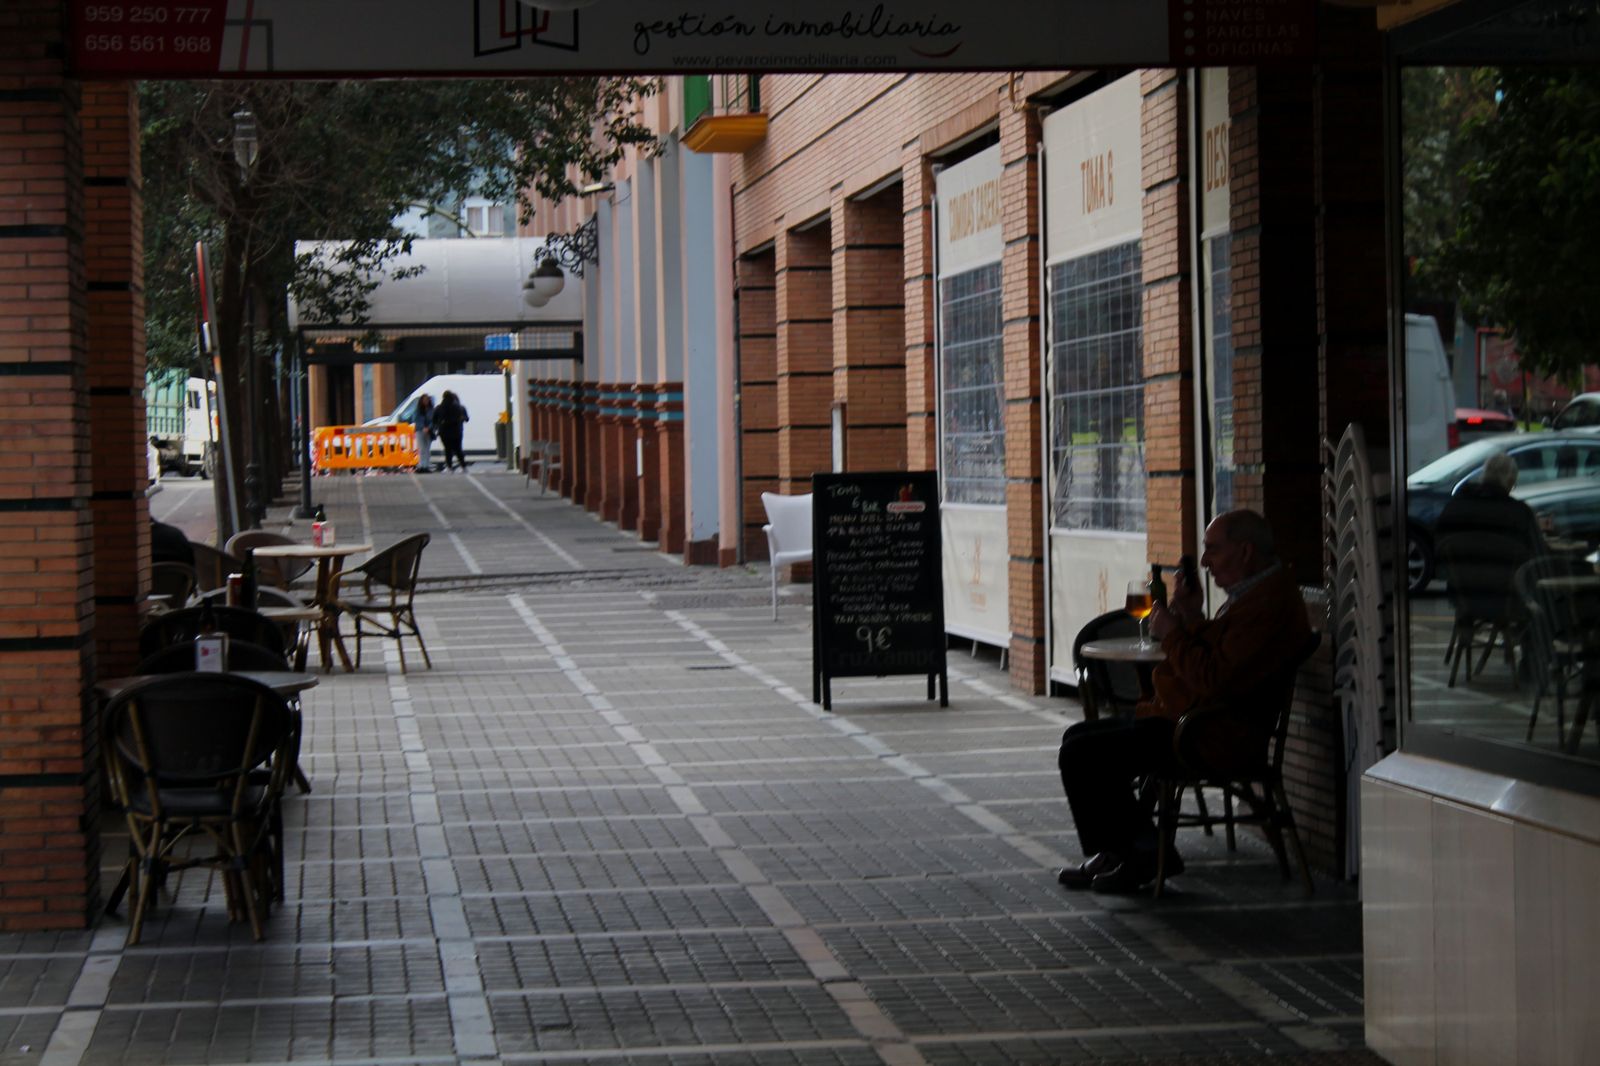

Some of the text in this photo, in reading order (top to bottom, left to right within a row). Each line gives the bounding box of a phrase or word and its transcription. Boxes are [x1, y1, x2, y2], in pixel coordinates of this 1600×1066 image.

[85, 5, 212, 23] 959 250 777
[1205, 7, 1266, 22] NAVES
[633, 3, 961, 55] gestión inmobiliaria
[1206, 24, 1301, 39] PARCELAS
[85, 34, 212, 53] 656 561 968
[1206, 41, 1295, 57] OFICINAS
[672, 53, 897, 68] www.pevaroinmobiliaria.com
[1206, 121, 1231, 192] DES
[1081, 153, 1105, 215] TOMA
